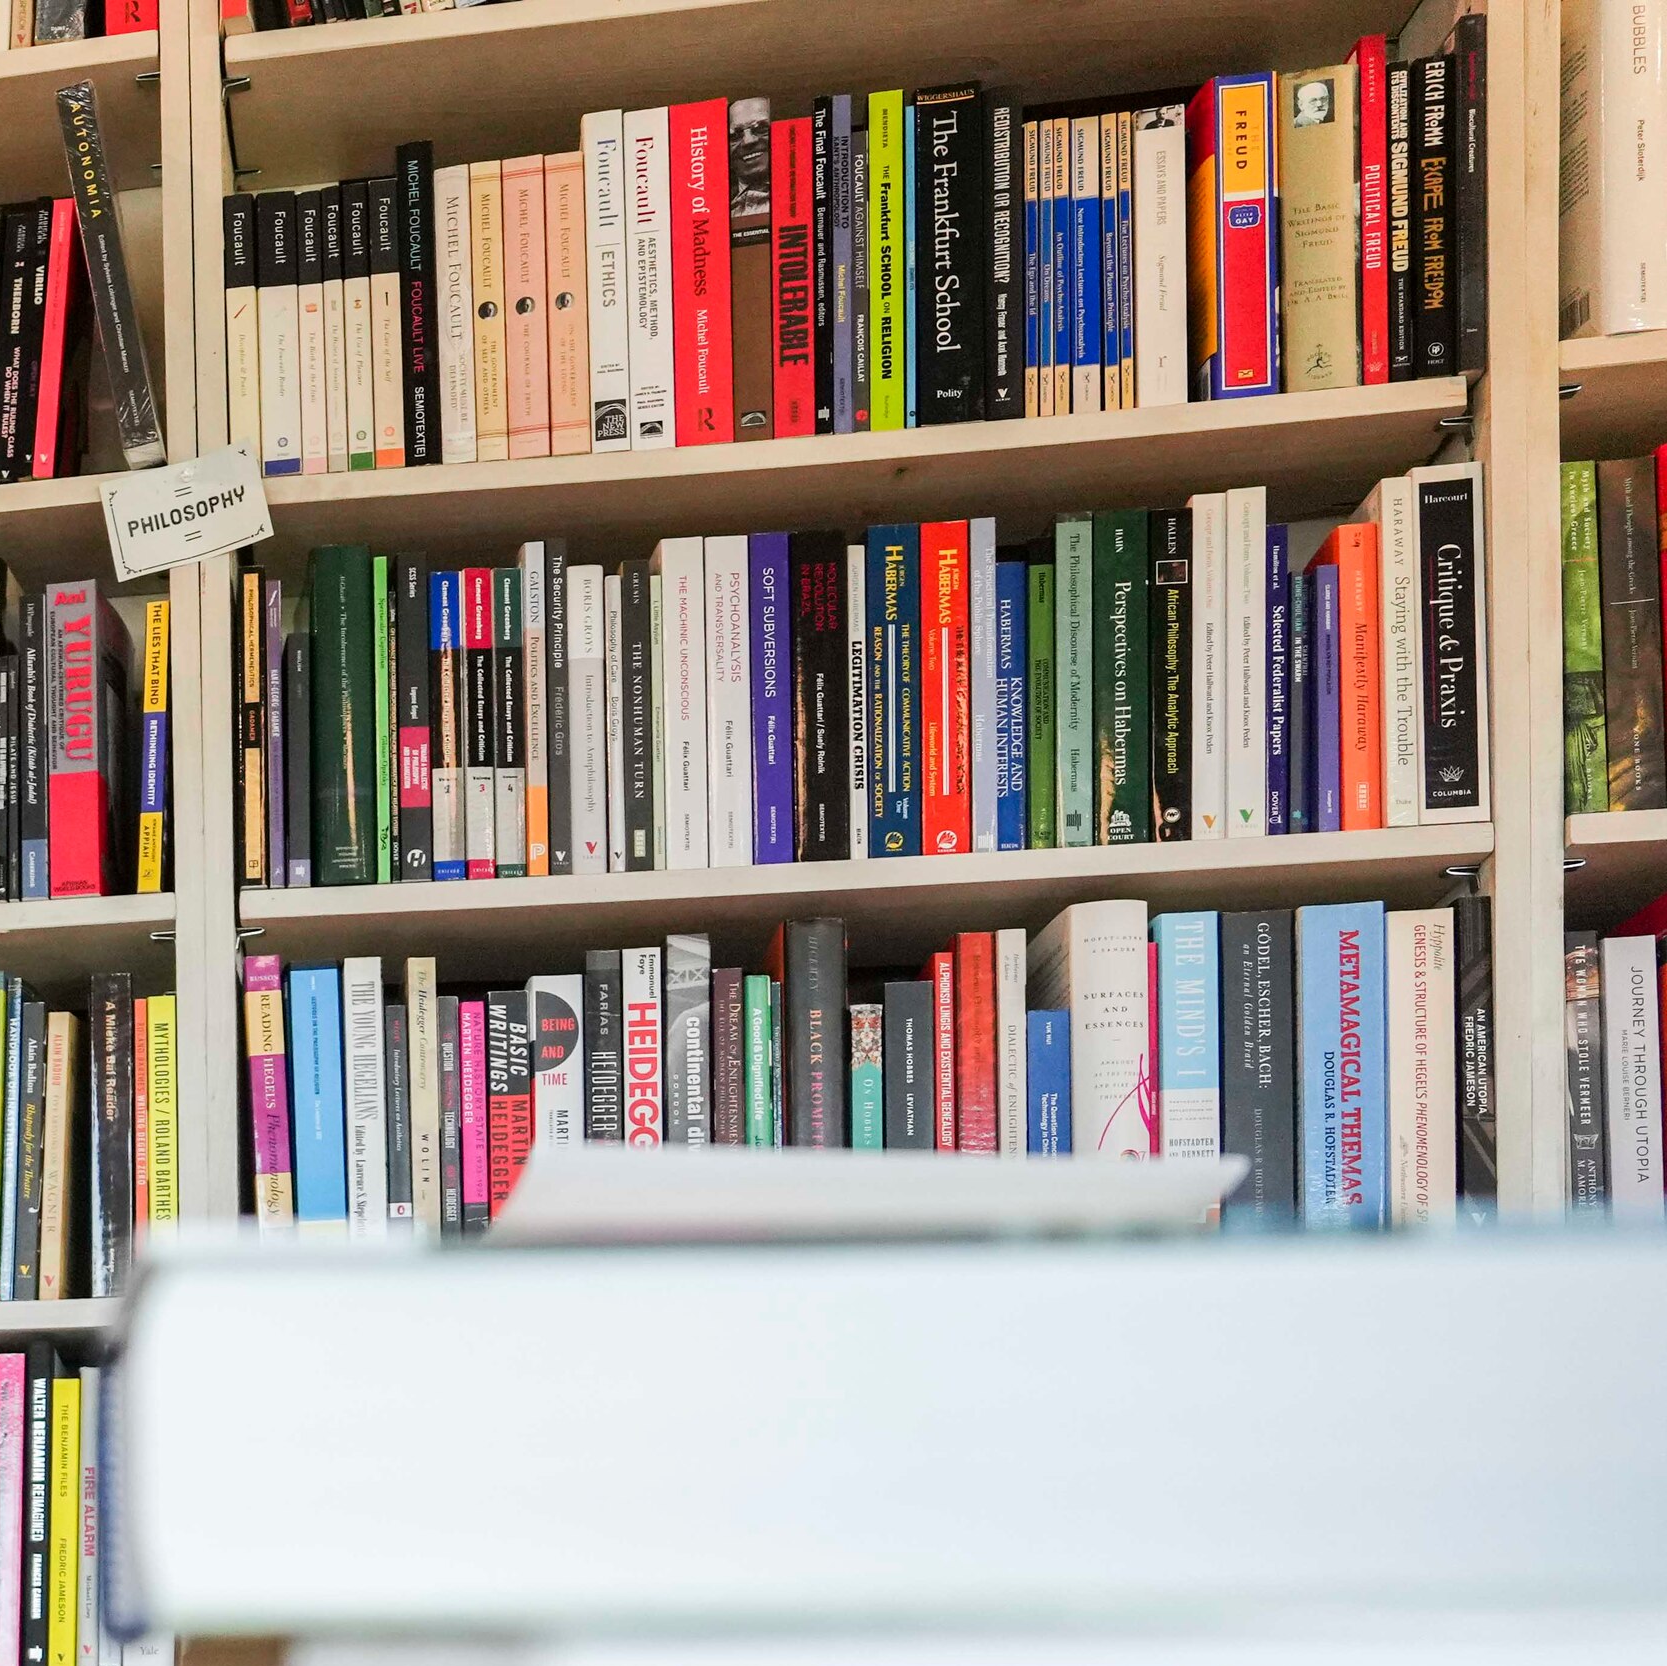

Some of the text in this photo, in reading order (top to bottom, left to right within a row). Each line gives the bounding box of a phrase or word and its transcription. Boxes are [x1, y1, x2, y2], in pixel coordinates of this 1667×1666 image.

[1632, 4, 1647, 74] BUBBLES
[70, 102, 102, 218] AUTONOMIA
[1235, 110, 1247, 171] FREUD
[327, 204, 340, 258] Foucault
[351, 202, 365, 256] Foucault
[379, 197, 392, 251] Foucault
[597, 138, 618, 309] Foucault ETHICS
[688, 126, 711, 297] History of Madness
[880, 183, 892, 240] Frankfurt
[932, 110, 962, 353] The Frankfurt School
[1392, 142, 1409, 272] SIGMUND FREUD
[232, 212, 246, 266] Foucault
[274, 211, 287, 265] Foucault
[304, 209, 317, 263] Foucault
[780, 224, 809, 368] INTOLERABLE
[880, 245, 892, 299] SCHOOL
[883, 302, 891, 313] ON
[881, 316, 892, 379] RELIGION
[936, 388, 963, 399] Polity
[128, 485, 245, 538] PHILOSOPHY
[1424, 492, 1468, 505] Harcourt
[885, 545, 903, 621] HABERMAS
[150, 604, 162, 705] THE LIES THAT BIND
[762, 566, 776, 698] SOFT SUBVERSIONS
[1437, 543, 1466, 729] Critique & Praxis
[64, 614, 94, 762] YURUGU
[851, 640, 864, 790] LEGITIMATION CRISIS
[1432, 789, 1472, 798] COLUMBIA
[1084, 990, 1144, 1000] SURFACES
[1103, 1005, 1129, 1014] AND
[1255, 923, 1271, 1089] GÖDEL, ESCHER, BACH:
[541, 1017, 575, 1032] BEING
[541, 1045, 565, 1059] AND
[1085, 1020, 1144, 1030] ESSENCES
[541, 1073, 568, 1086] TIME
[1339, 930, 1363, 1205] METAMAGICAL THEMAS
[84, 1467, 95, 1557] FIRE ALARM
